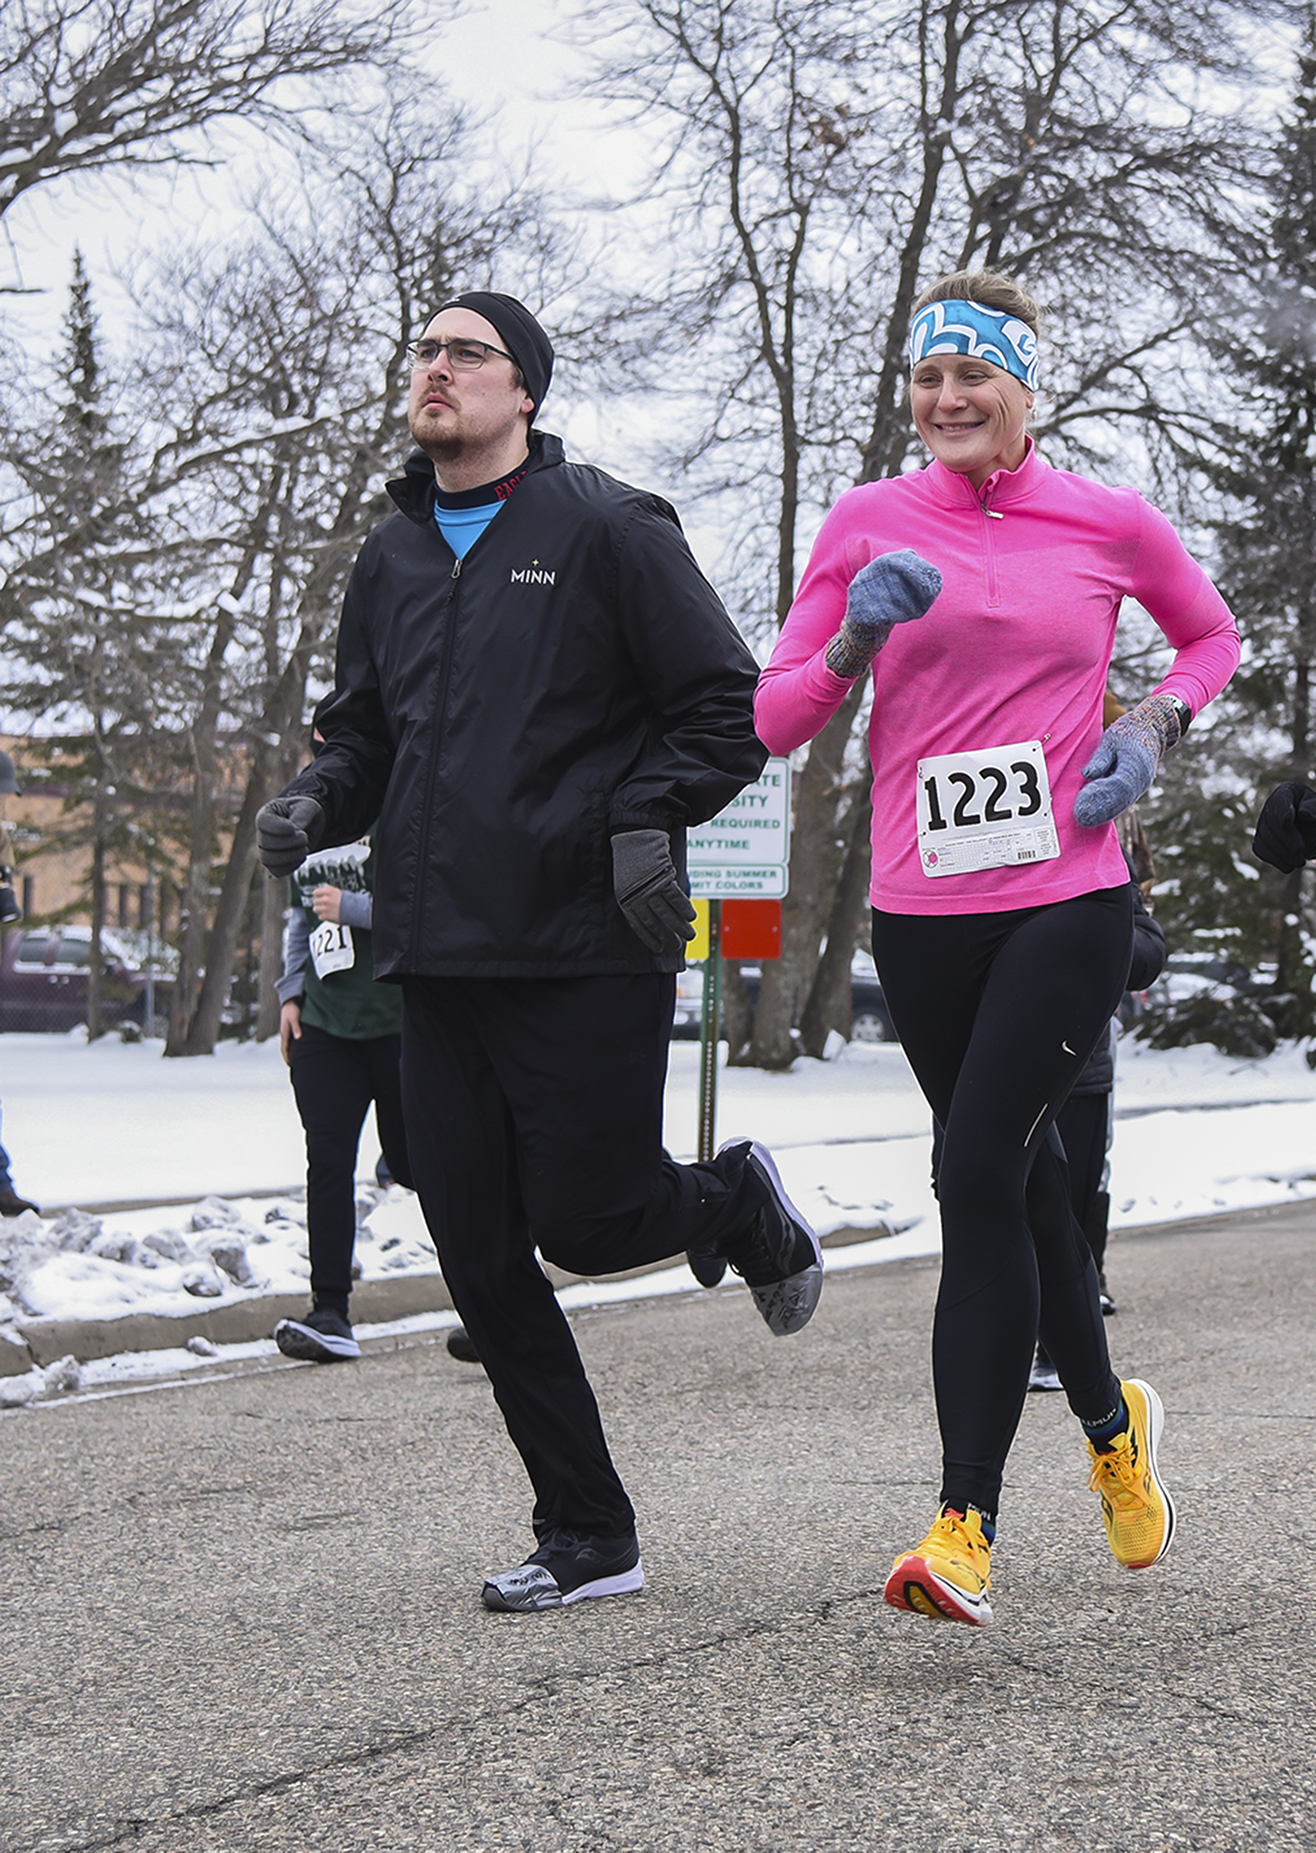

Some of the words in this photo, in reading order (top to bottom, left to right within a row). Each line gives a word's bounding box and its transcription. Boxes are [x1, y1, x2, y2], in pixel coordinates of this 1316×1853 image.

[510, 569, 556, 586] MINN
[924, 761, 1042, 831] 1223
[710, 819, 781, 829] REQUIRED
[687, 839, 750, 850] ANYTIME
[726, 870, 777, 878] SUMMER
[716, 881, 763, 890] COLORS
